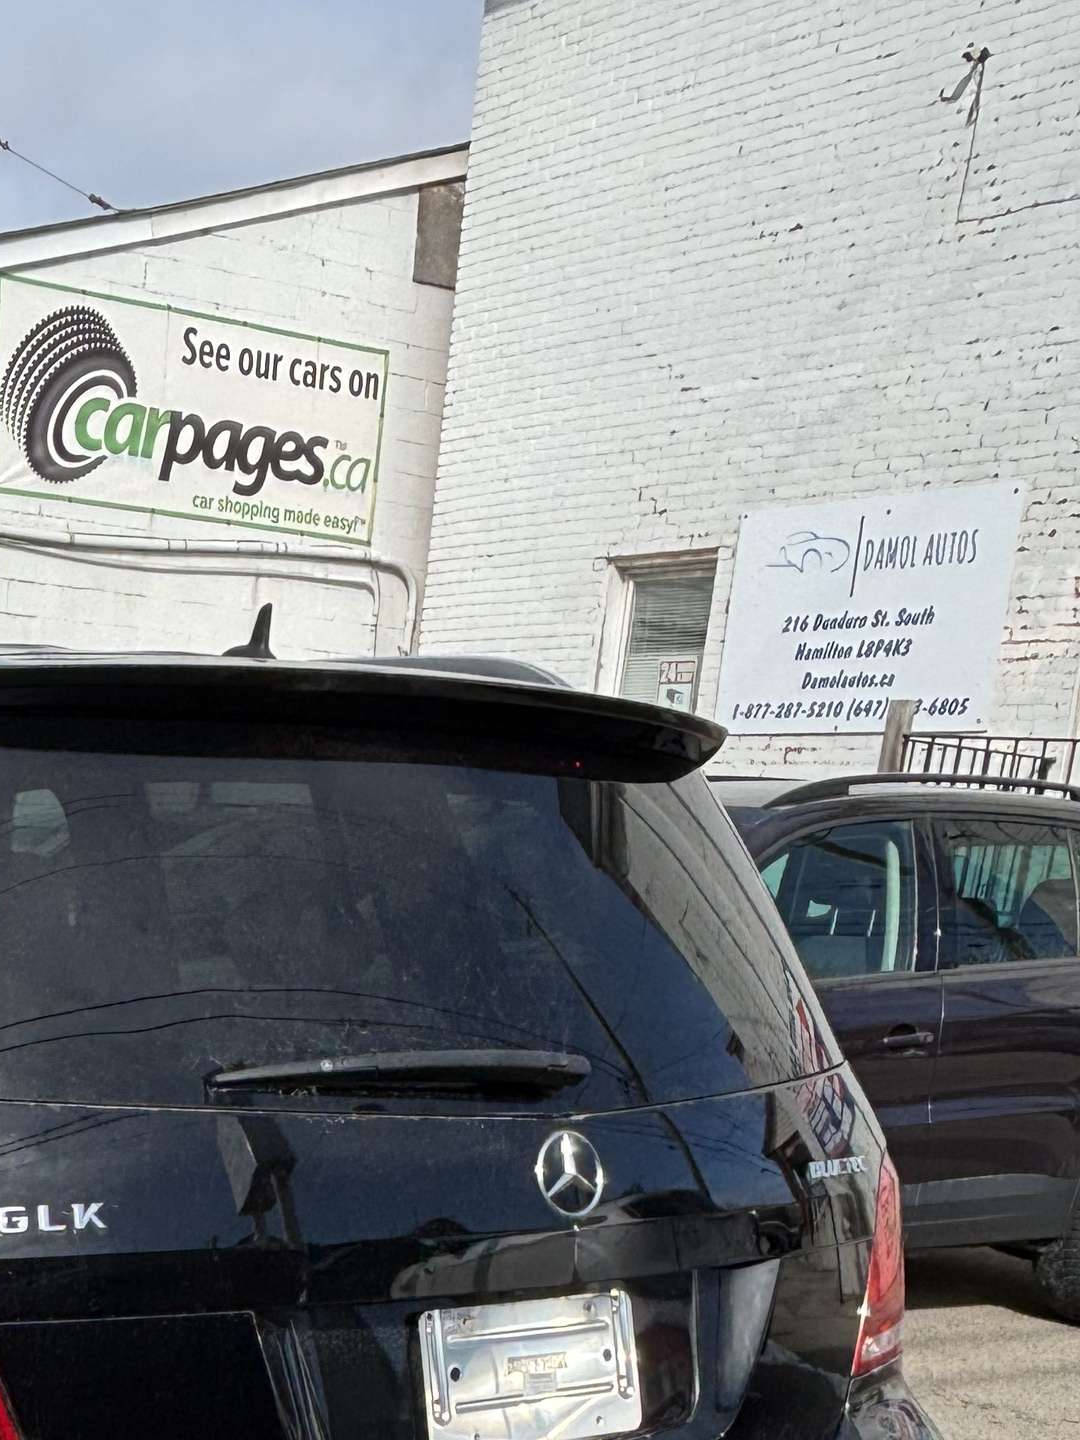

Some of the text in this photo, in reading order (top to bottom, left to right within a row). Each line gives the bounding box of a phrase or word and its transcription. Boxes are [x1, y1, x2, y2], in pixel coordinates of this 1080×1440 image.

[181, 326, 379, 400] See our cars on
[192, 494, 214, 510] car
[217, 496, 280, 523] shopping
[283, 508, 320, 526] made
[863, 528, 979, 571] DAMOL AUTOS
[782, 615, 809, 633] 216
[871, 609, 890, 628] St.
[895, 605, 935, 626] South
[795, 641, 853, 660] Hamilton
